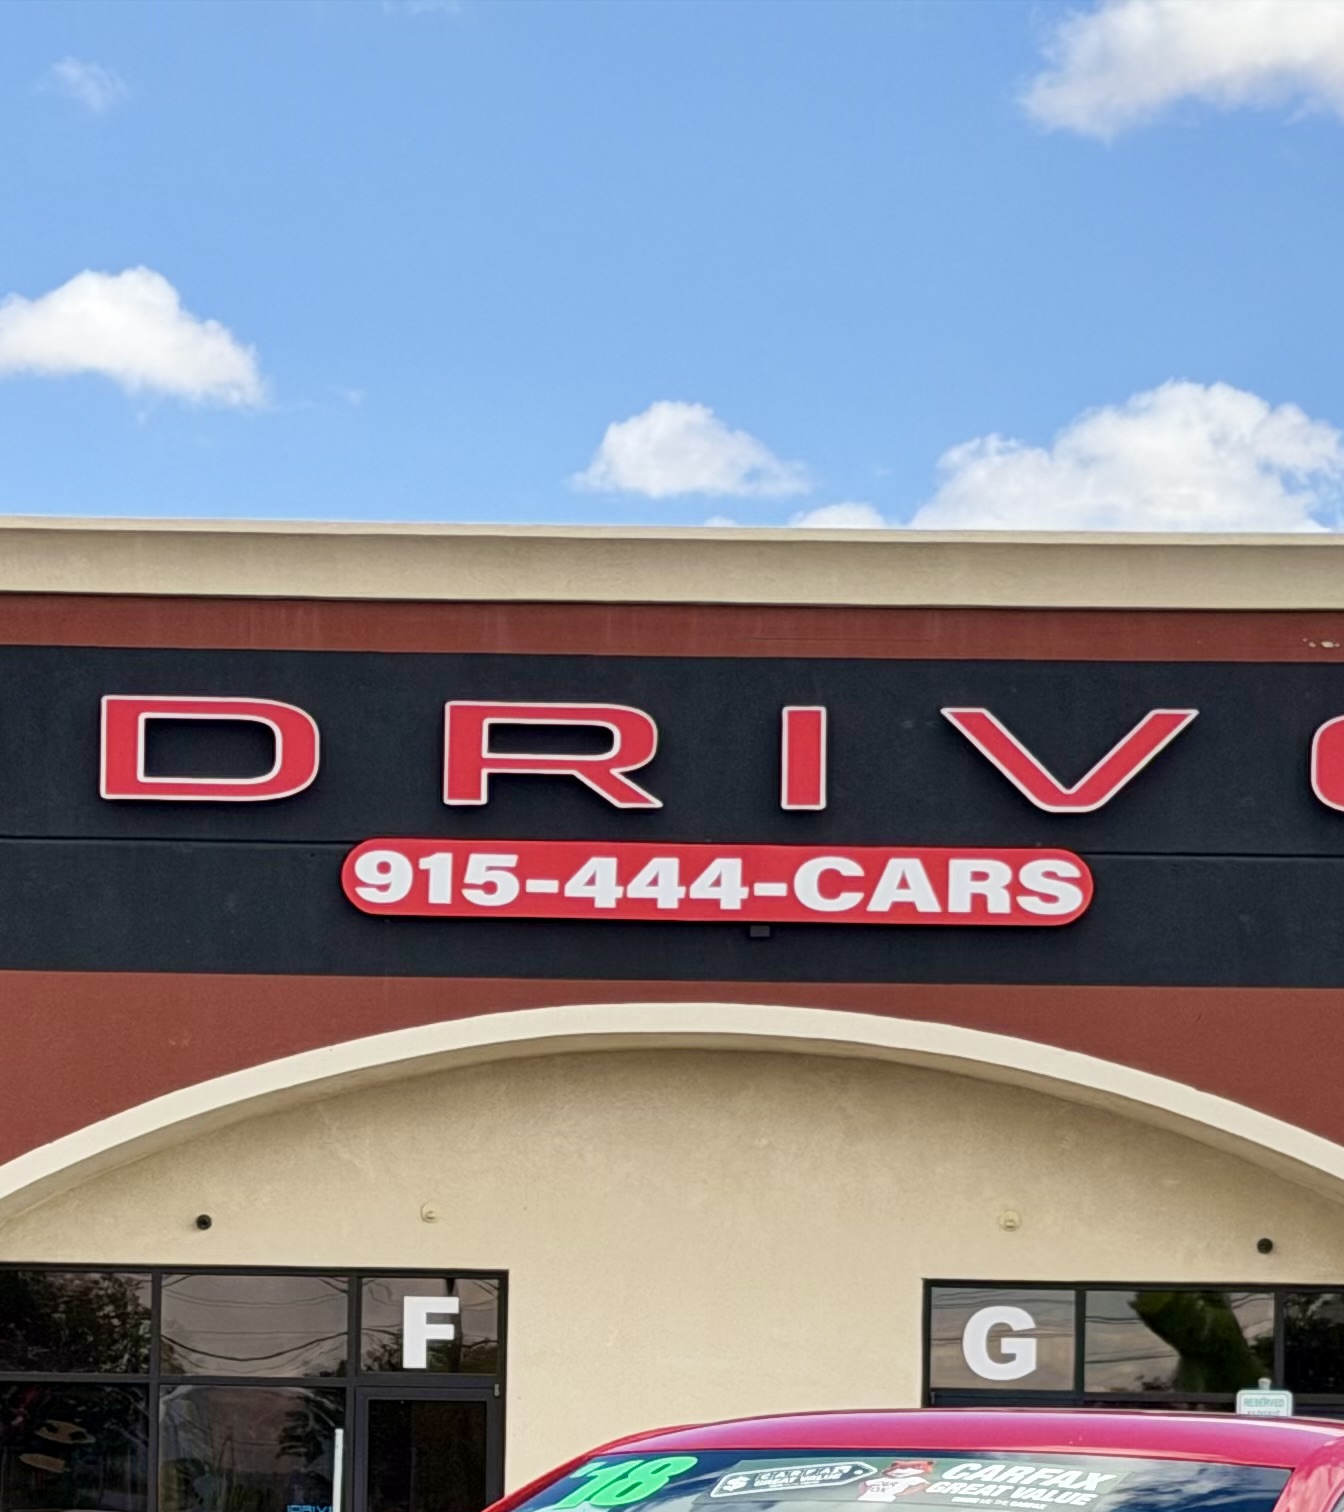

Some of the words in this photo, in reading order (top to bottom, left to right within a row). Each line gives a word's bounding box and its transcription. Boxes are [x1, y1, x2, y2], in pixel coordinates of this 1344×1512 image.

[353, 850, 1084, 916] 915-444-CARS
[403, 1296, 459, 1369] F
[962, 1305, 1037, 1381] G
[926, 1481, 1013, 1497] GREAT
[1012, 1486, 1099, 1506] VALUE
[942, 1463, 1119, 1491] CARFAX
